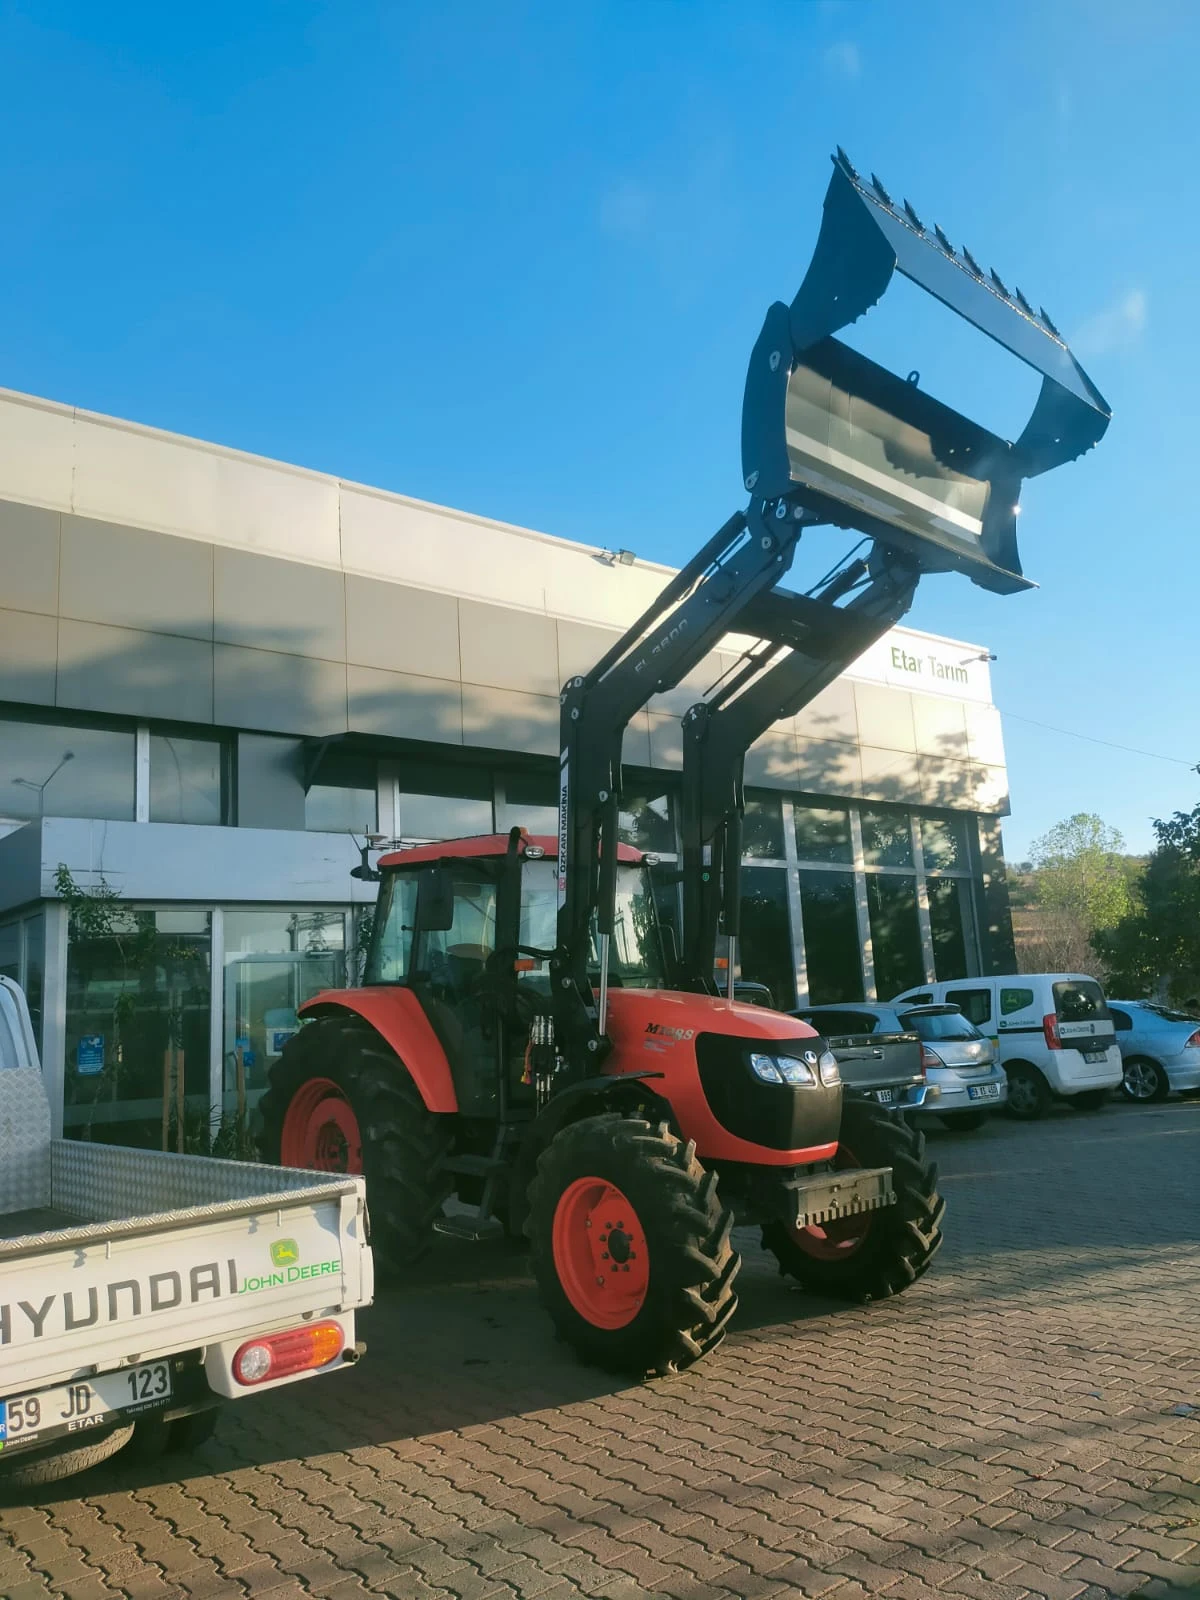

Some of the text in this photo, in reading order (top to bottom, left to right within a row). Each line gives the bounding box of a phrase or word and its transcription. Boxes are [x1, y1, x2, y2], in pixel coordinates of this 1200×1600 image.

[890, 646, 923, 674] Etar
[238, 1259, 341, 1294] JOHN DEERE
[8, 1397, 41, 1432] 59
[61, 1384, 91, 1419] JD
[128, 1365, 168, 1400] 123
[68, 1414, 104, 1432] ETAR
